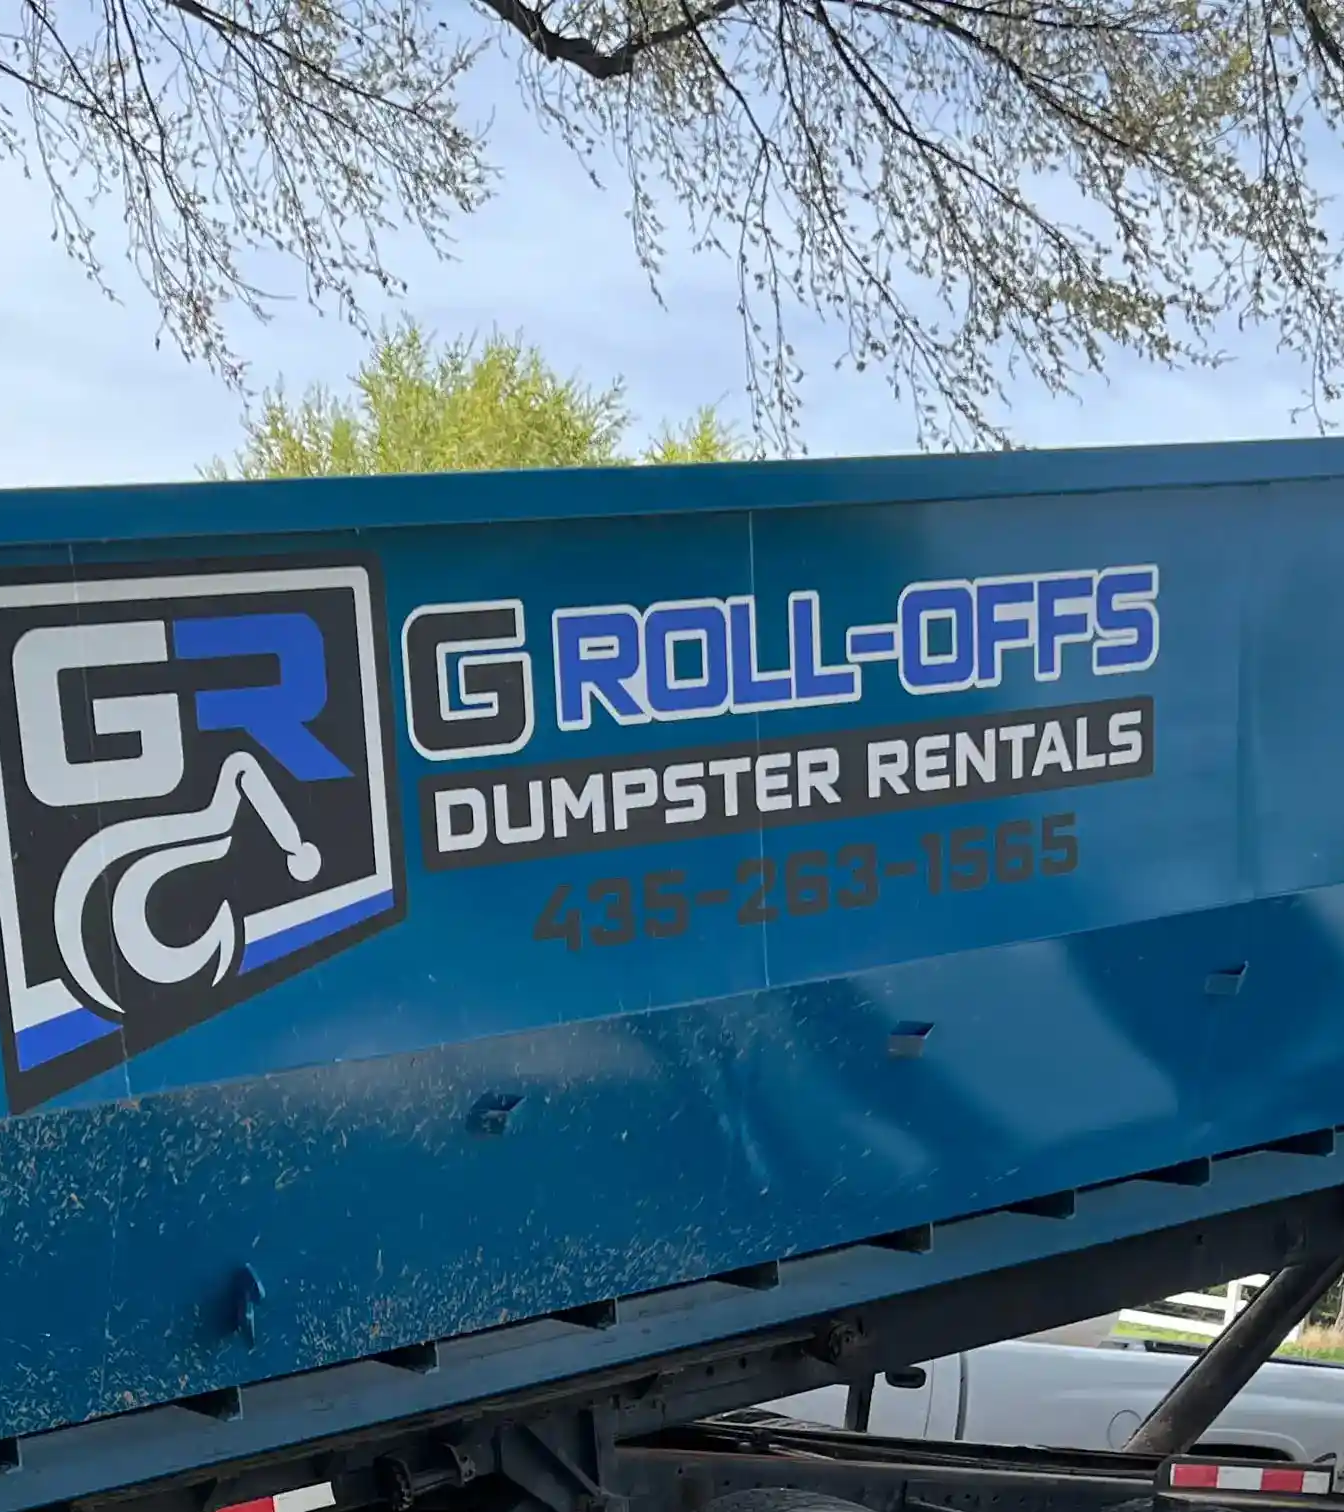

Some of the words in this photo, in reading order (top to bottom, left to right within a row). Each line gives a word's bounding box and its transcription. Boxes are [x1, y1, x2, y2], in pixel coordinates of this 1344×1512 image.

[10, 612, 356, 808] GR
[401, 597, 535, 762] G
[551, 563, 1160, 732] ROLL-OFFS
[433, 746, 843, 854] DUMPSTER
[866, 709, 1146, 800] RENTALS
[533, 813, 1080, 952] 435-263-1565
